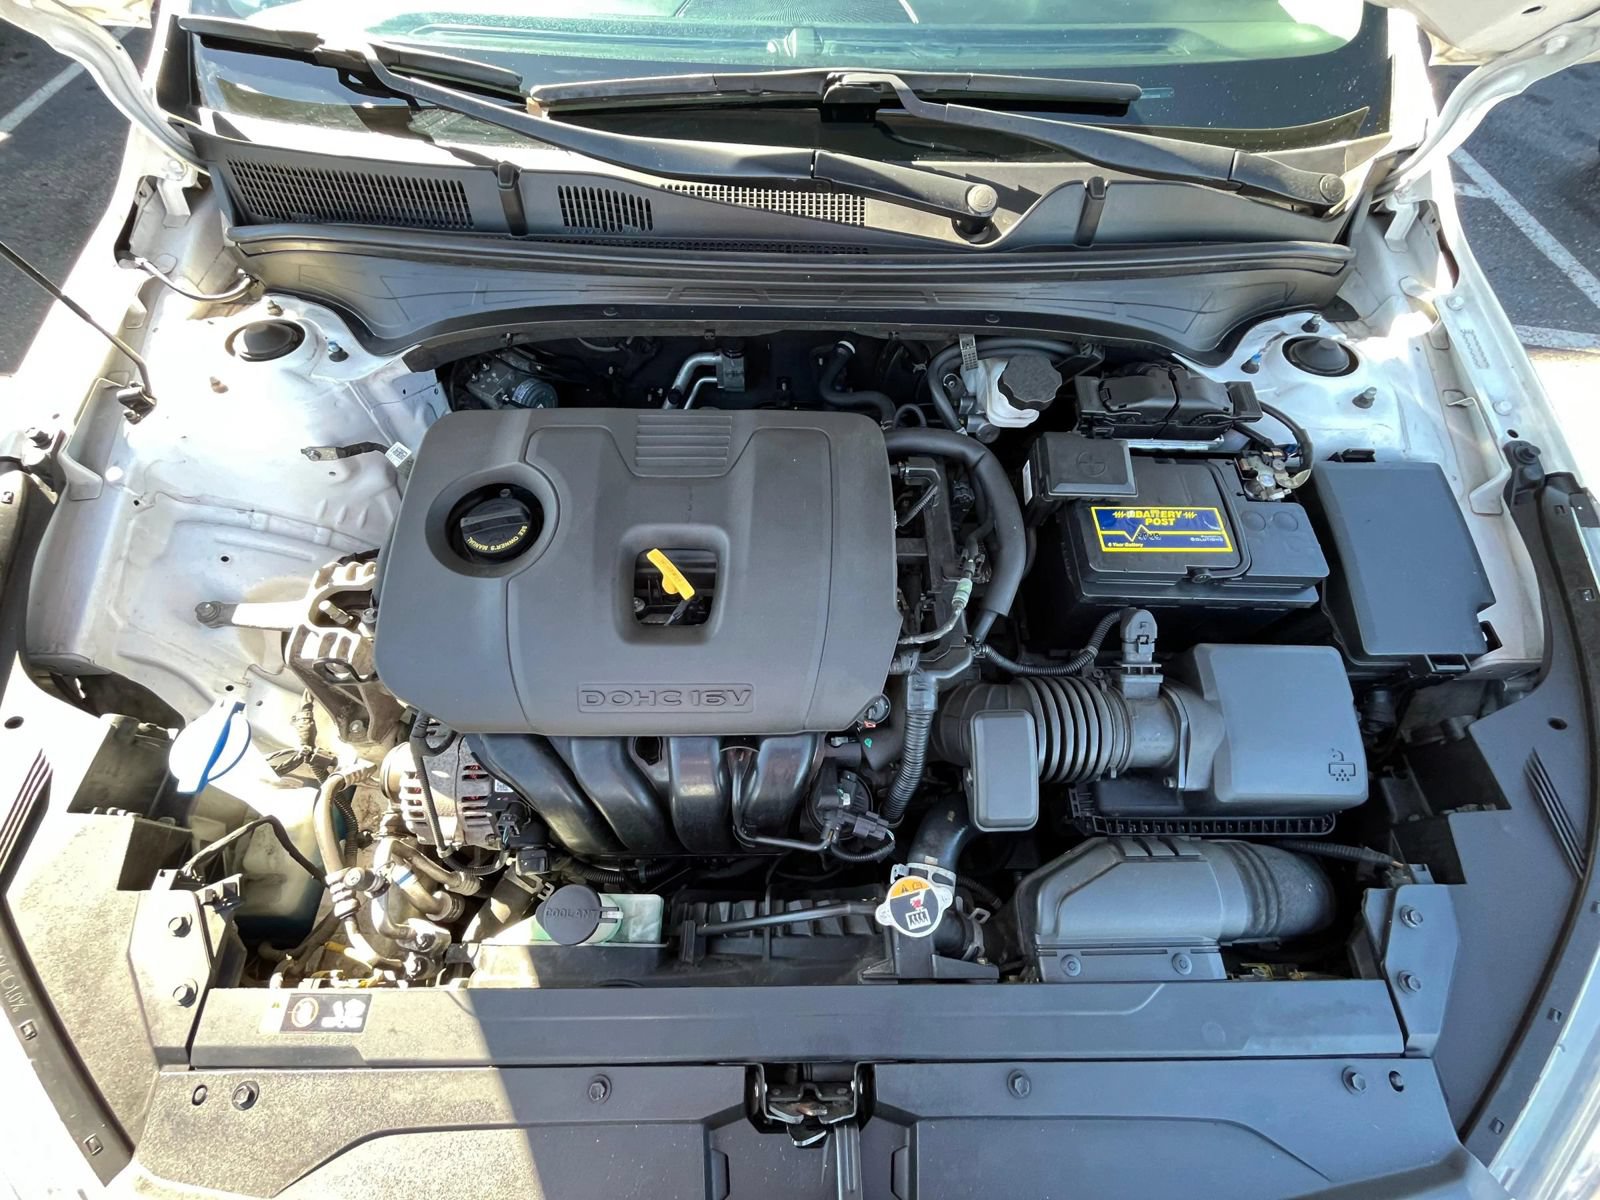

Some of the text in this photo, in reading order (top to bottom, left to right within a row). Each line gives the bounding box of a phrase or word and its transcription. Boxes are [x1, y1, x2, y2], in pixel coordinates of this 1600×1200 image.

[1135, 509, 1182, 519] BATTERY
[1145, 518, 1176, 526] POST
[467, 525, 528, 551] SEE OWNER'S MANUAL
[580, 690, 752, 706] DOHC 16V
[546, 907, 598, 919] COOLANT
